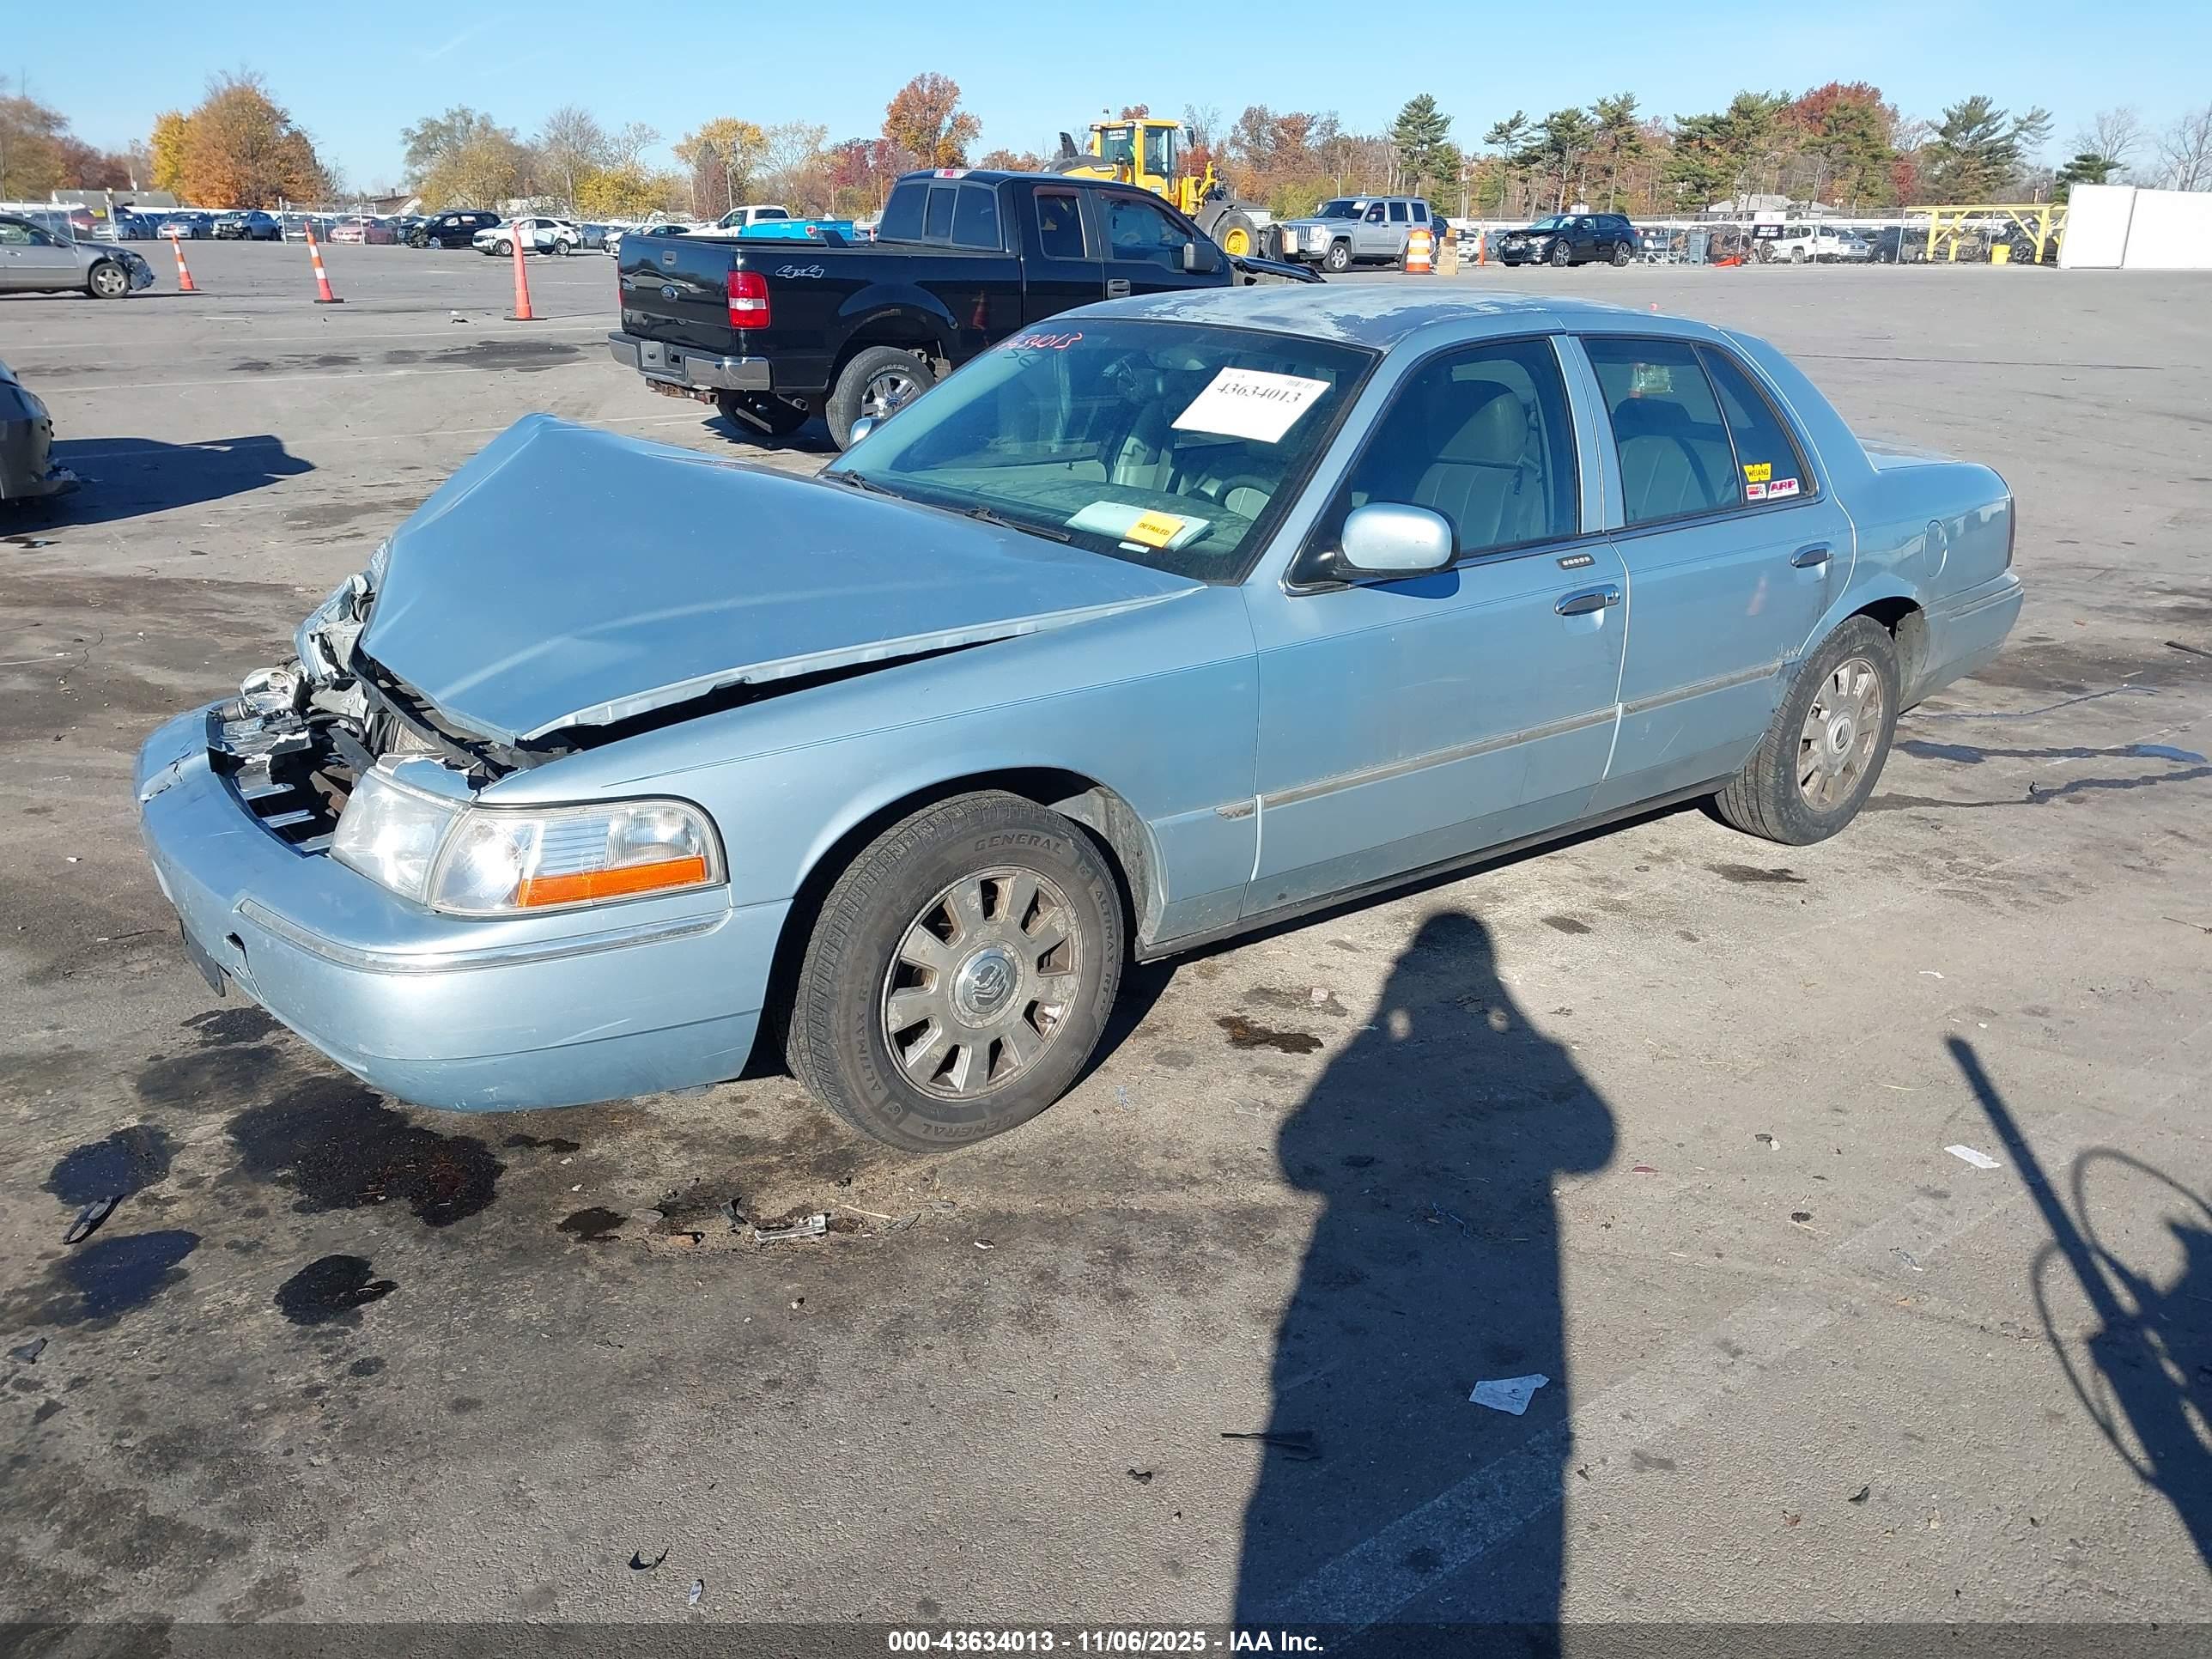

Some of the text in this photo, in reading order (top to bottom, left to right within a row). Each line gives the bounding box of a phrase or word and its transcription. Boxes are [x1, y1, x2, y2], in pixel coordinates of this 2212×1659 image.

[775, 264, 824, 278] 4x4
[1217, 383, 1303, 404] 43634013
[1770, 479, 1796, 491] ARP
[974, 834, 1062, 854] GENERAL
[1095, 890, 1115, 964] ALTIMAX
